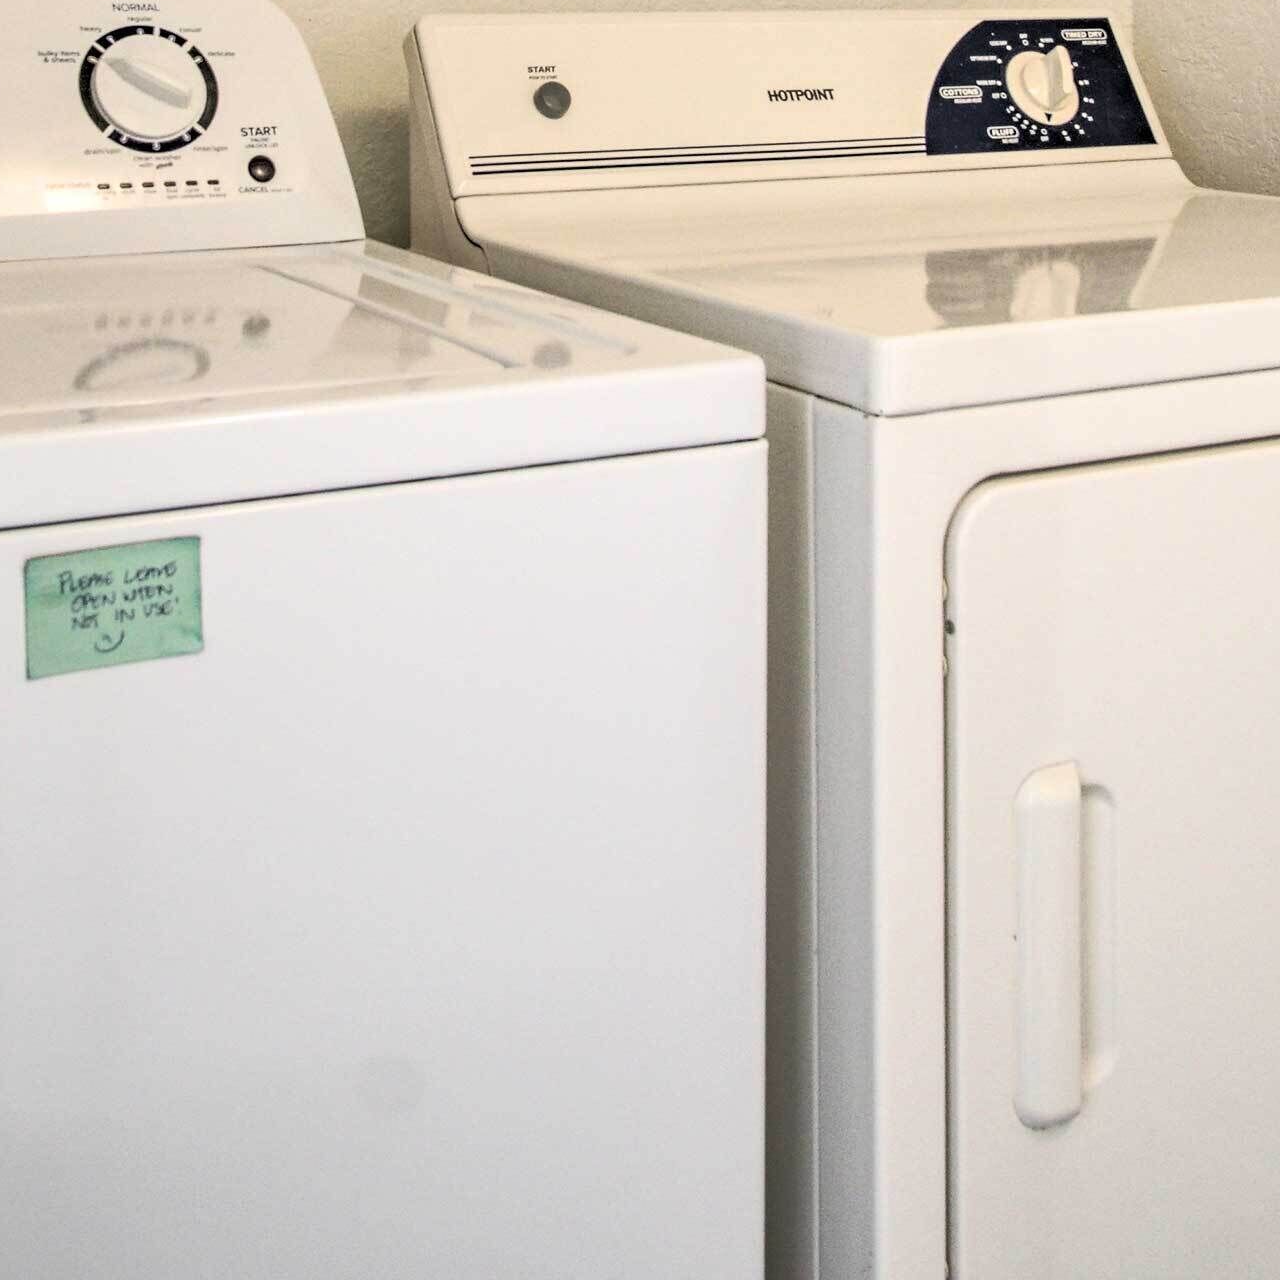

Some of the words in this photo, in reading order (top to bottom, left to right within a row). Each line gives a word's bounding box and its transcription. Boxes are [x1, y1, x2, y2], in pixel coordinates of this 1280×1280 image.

[112, 3, 160, 12] NORMAL
[768, 88, 835, 102] HOTPOINT
[943, 88, 979, 96] COTTONS
[240, 126, 278, 137] START
[992, 127, 1014, 136] FLUFF
[115, 609, 135, 622] IN
